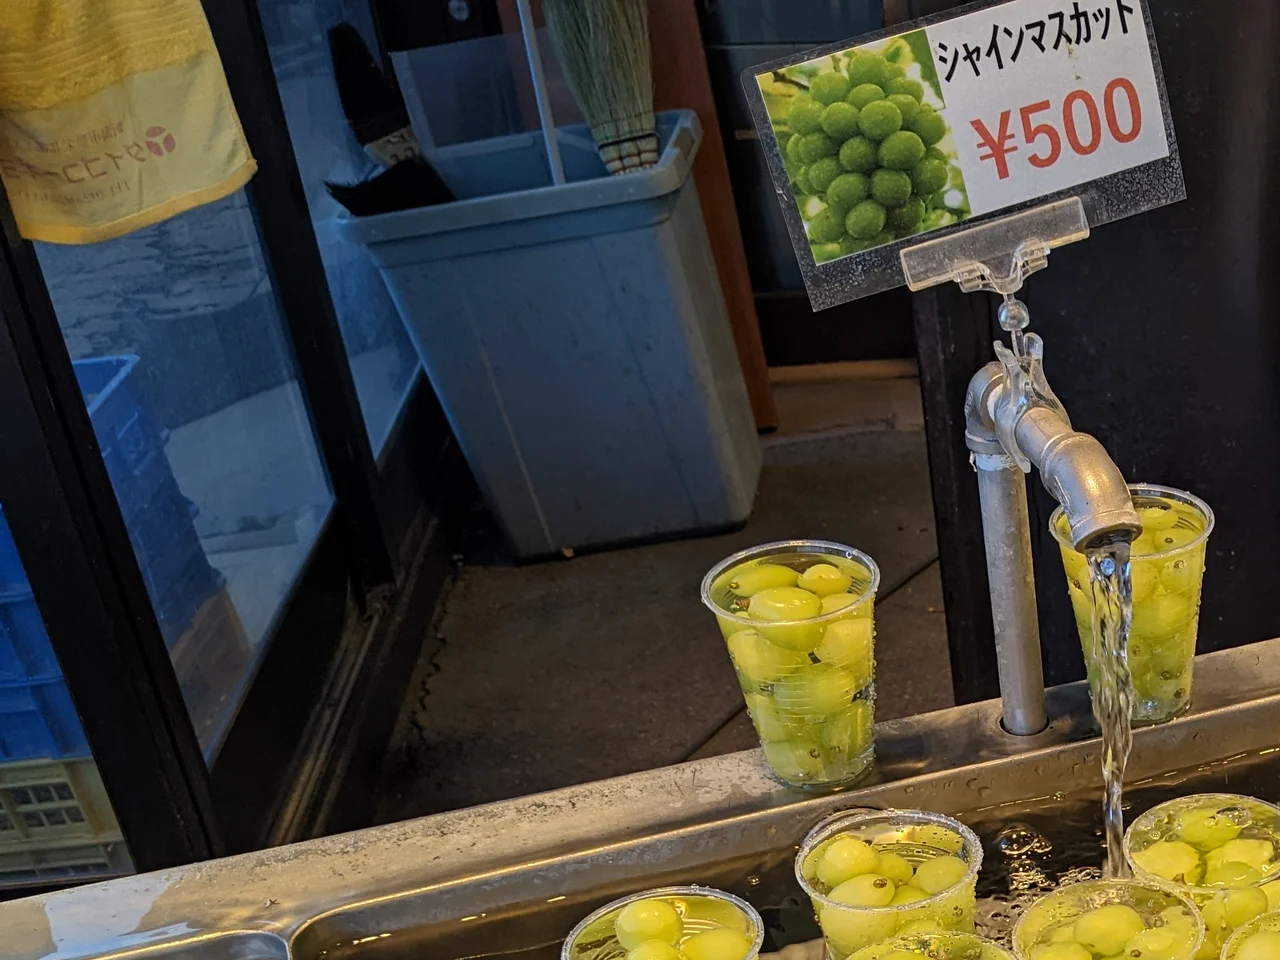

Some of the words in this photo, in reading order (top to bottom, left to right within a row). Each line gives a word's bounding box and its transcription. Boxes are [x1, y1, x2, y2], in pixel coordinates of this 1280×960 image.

[938, 0, 1134, 83] シャインマスカット
[970, 78, 1142, 180] ¥500
